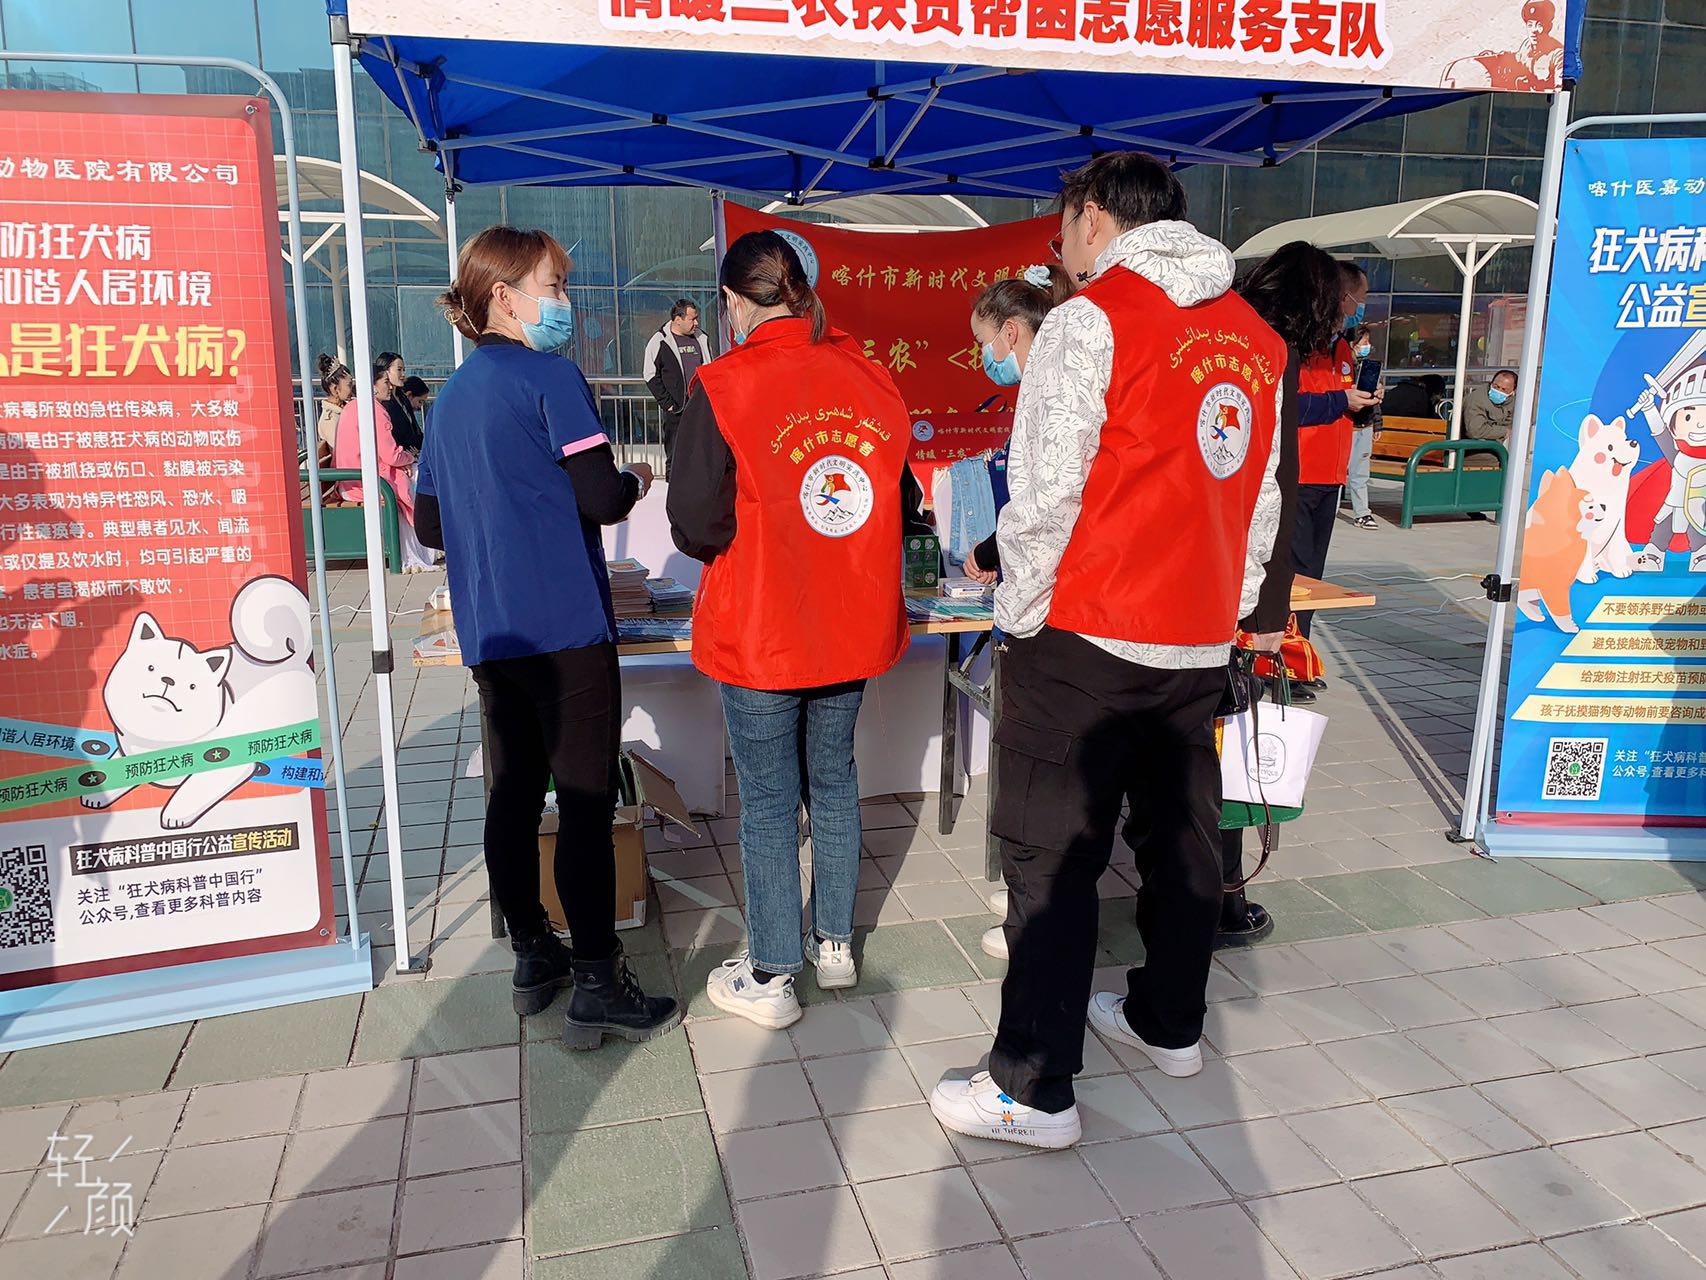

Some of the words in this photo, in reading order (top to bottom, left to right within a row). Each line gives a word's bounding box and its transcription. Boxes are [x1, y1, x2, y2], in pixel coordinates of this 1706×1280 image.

[1588, 177, 1706, 197] 喀什医嘉动
[0, 323, 247, 378] 是狂犬病?
[0, 400, 239, 419] 病毒所致的急性传染病，大多数
[789, 429, 876, 464] 喀什市志愿者
[0, 546, 252, 571] 或仅提及饮水时，均可引起严重的
[0, 727, 76, 752] 谐人居环境
[248, 728, 313, 756] 预防狂犬病
[124, 752, 194, 779] 预防狂犬病
[282, 764, 325, 783] 构建和
[76, 829, 293, 870] 狂犬病科普中国行公益宣传活动
